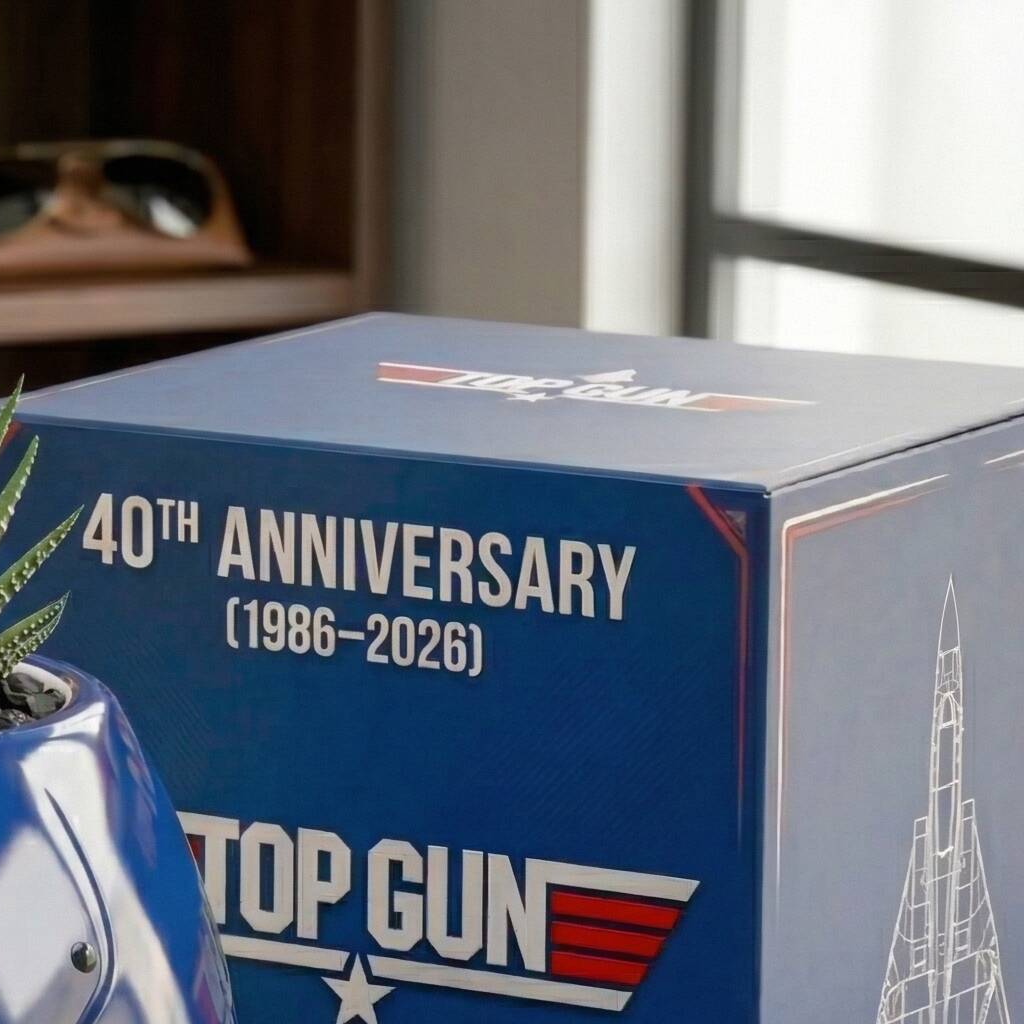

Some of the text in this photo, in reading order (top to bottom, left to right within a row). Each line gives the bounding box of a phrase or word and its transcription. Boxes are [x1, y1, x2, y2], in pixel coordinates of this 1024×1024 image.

[439, 371, 574, 395] TOP
[82, 492, 637, 621] 40TH ANNIVERSARY
[177, 811, 547, 973] TOP GUN
